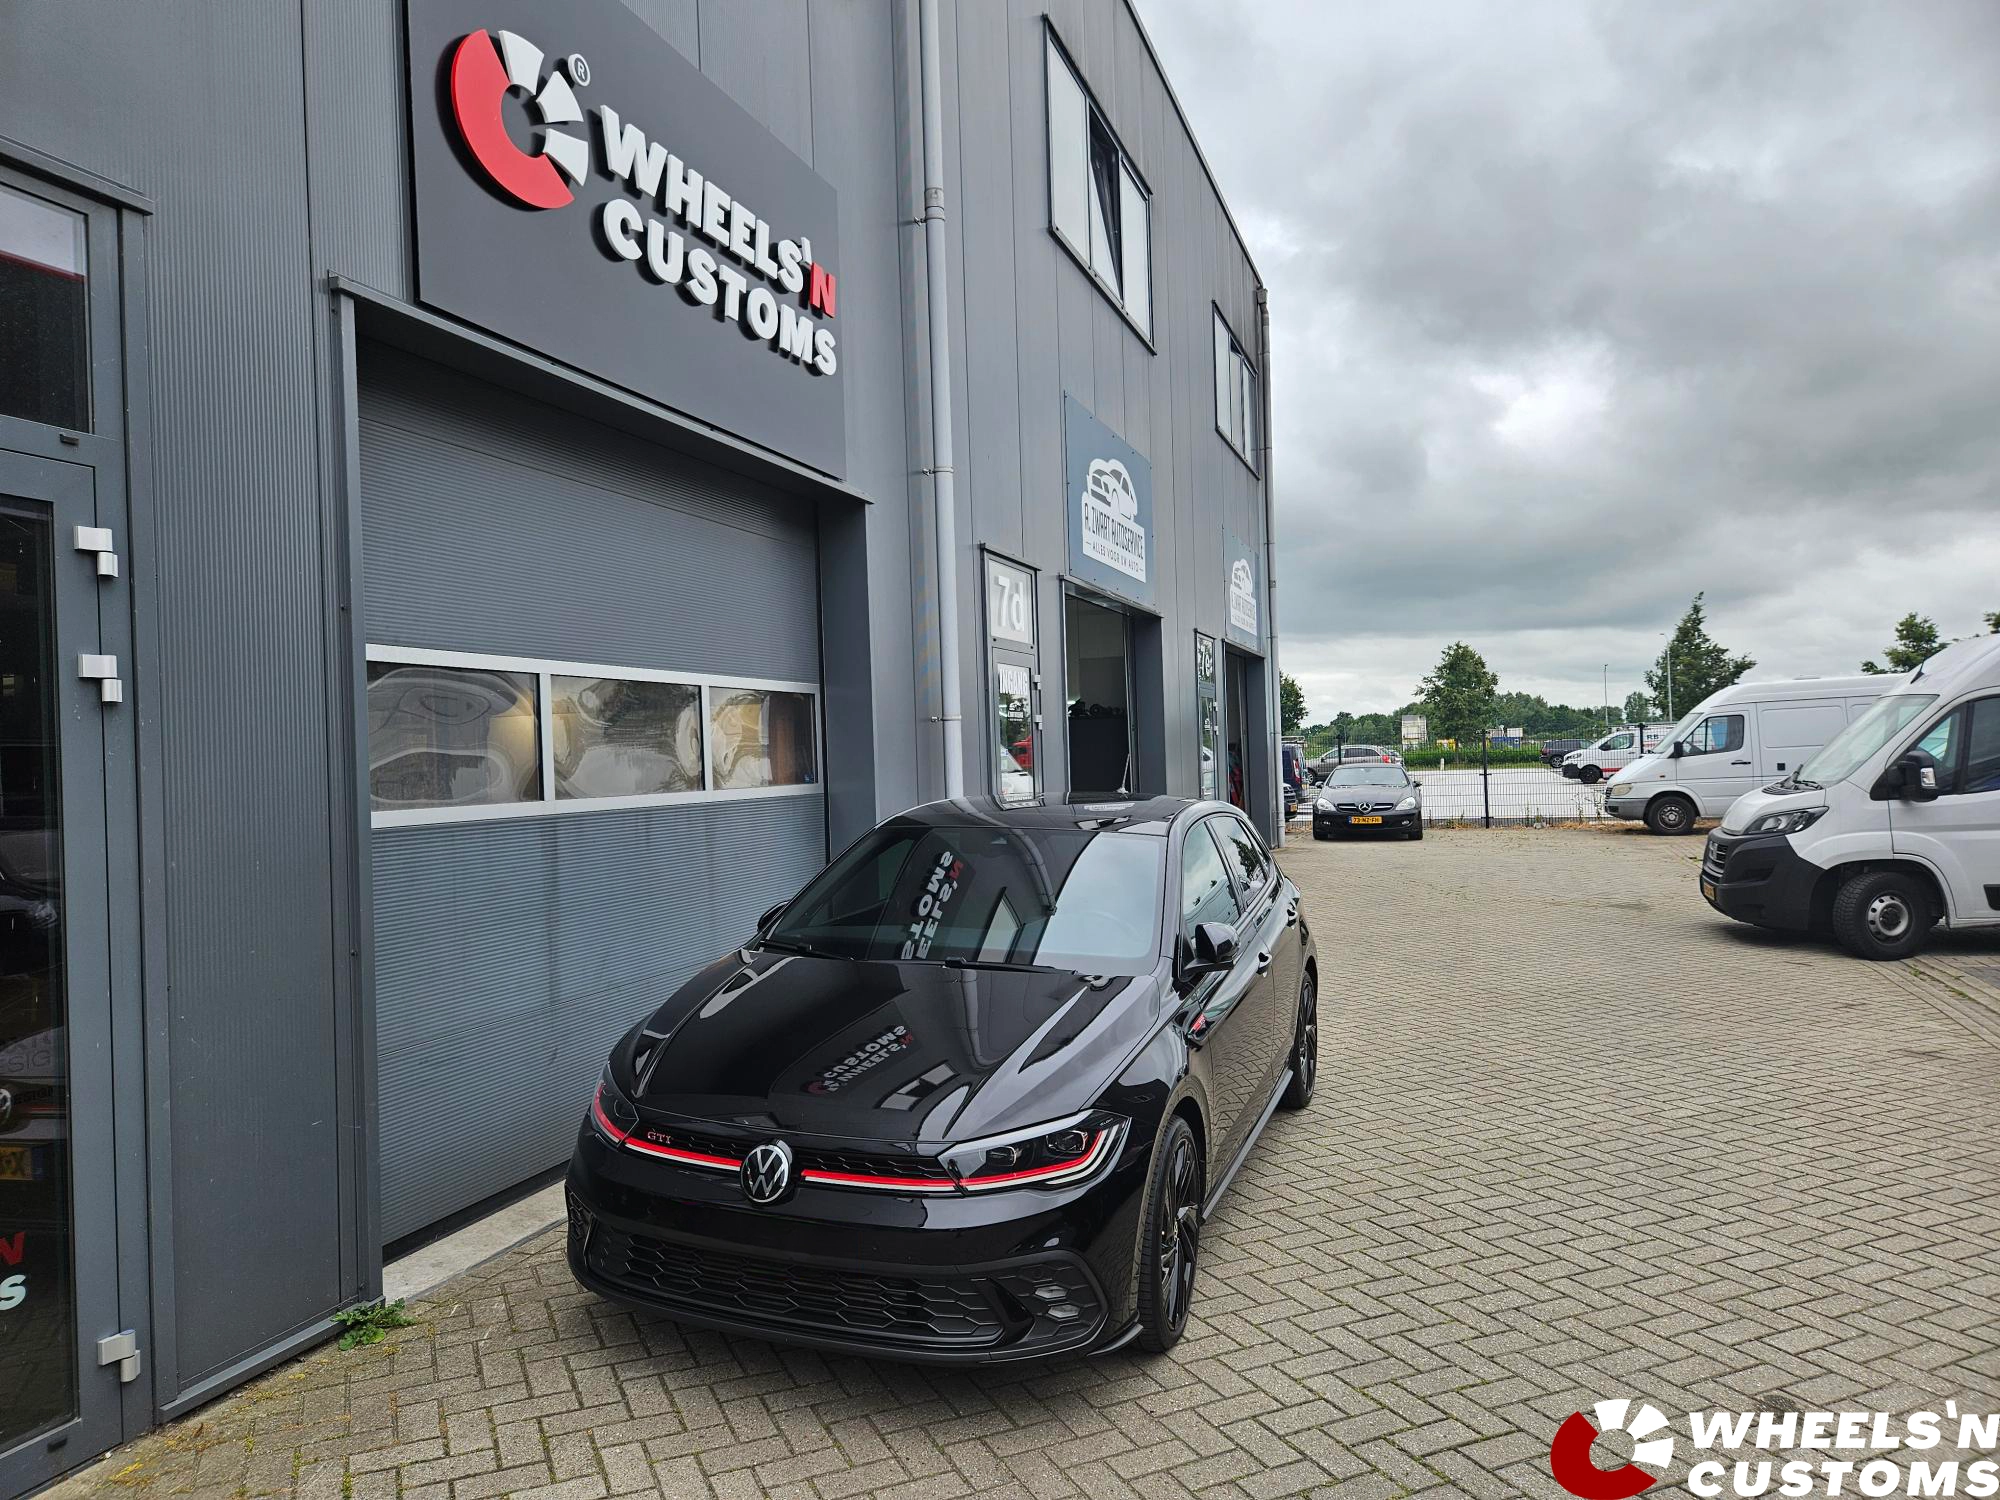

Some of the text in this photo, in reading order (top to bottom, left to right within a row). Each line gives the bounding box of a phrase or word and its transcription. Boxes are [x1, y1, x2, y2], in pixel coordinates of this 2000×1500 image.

[600, 104, 836, 318] WHEELS'N
[603, 199, 837, 376] CUSTOMS
[1091, 506, 1111, 542] ZWART
[1111, 518, 1144, 560] AUTOSERVICE
[995, 574, 1025, 632] 7d
[1000, 669, 1029, 696] INGANG
[647, 1131, 671, 1144] GTI
